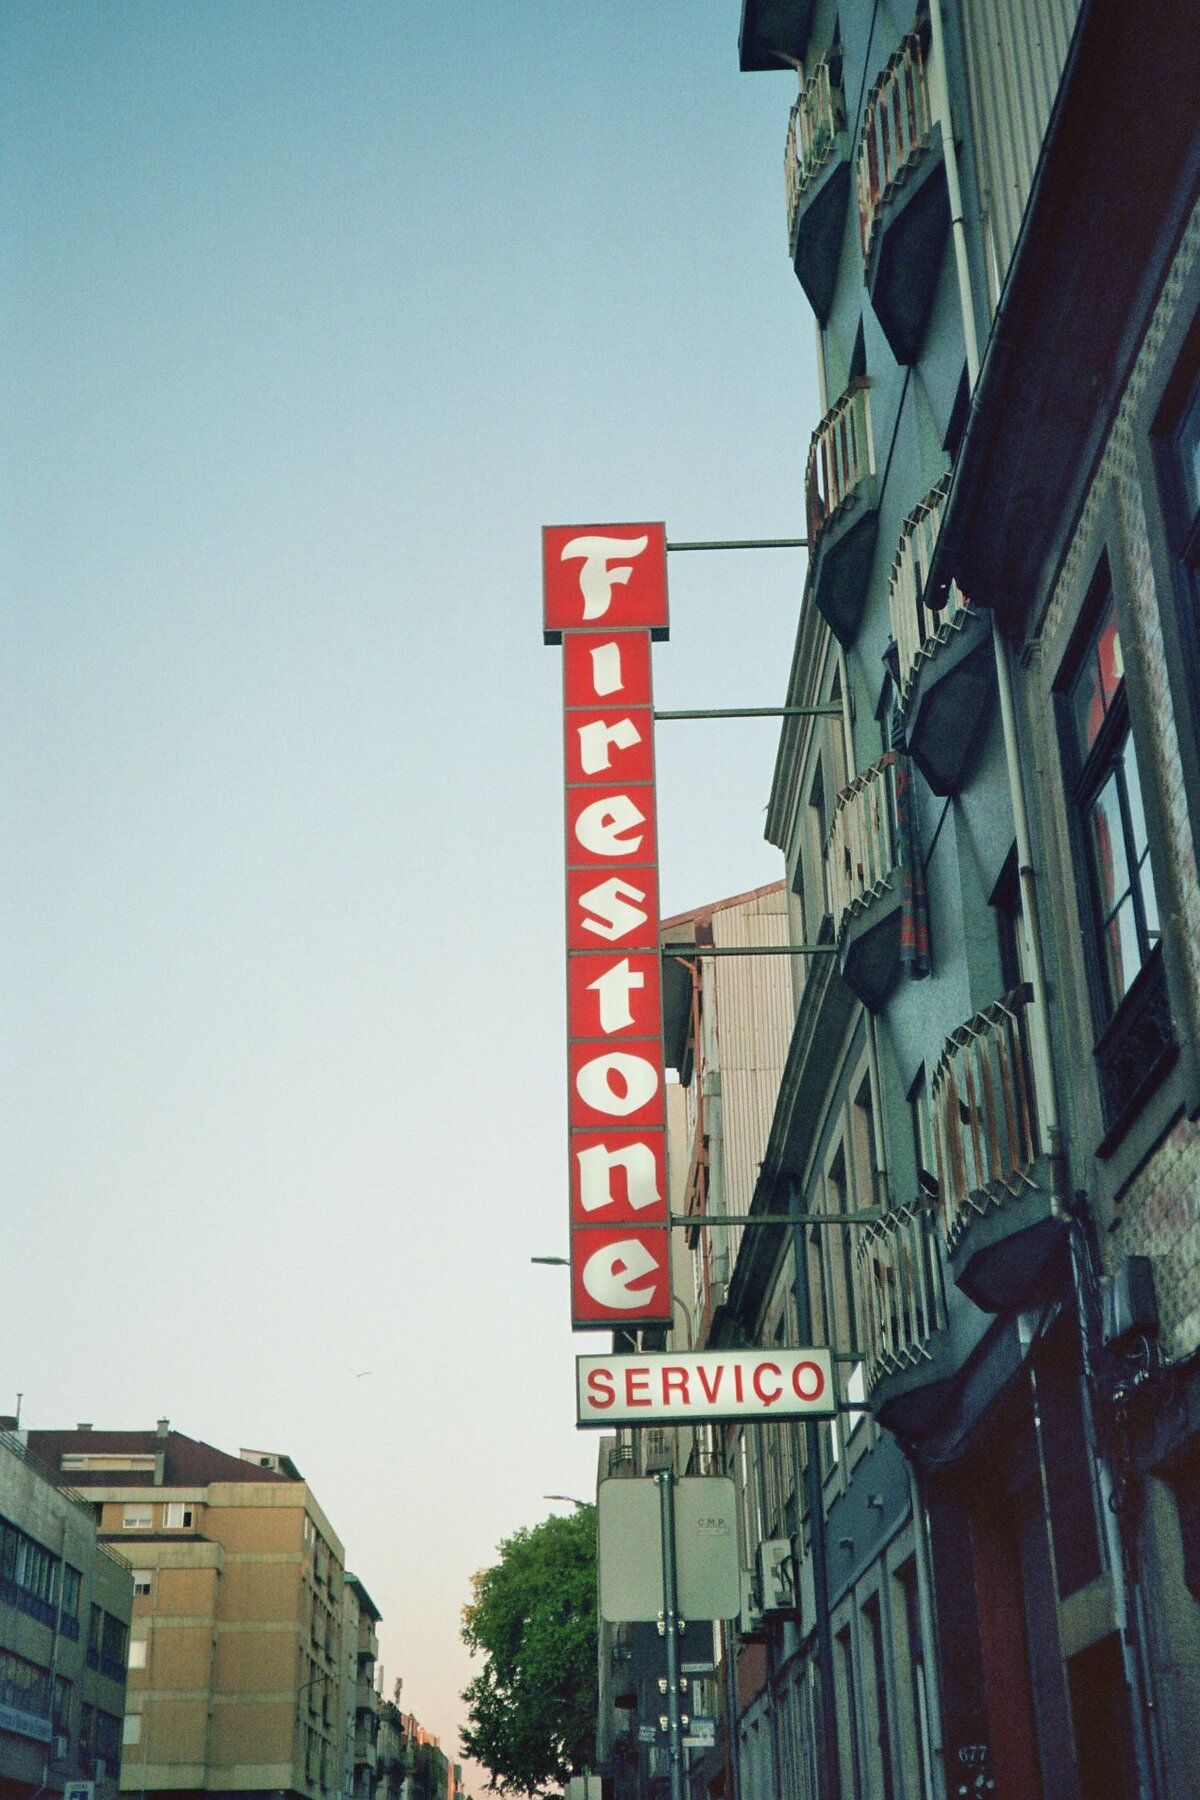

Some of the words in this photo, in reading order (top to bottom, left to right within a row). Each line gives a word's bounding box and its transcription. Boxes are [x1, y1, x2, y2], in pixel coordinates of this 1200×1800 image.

[560, 535, 661, 1310] Firestone
[587, 1360, 825, 1408] SERVIÇO
[958, 1745, 988, 1762] 677
